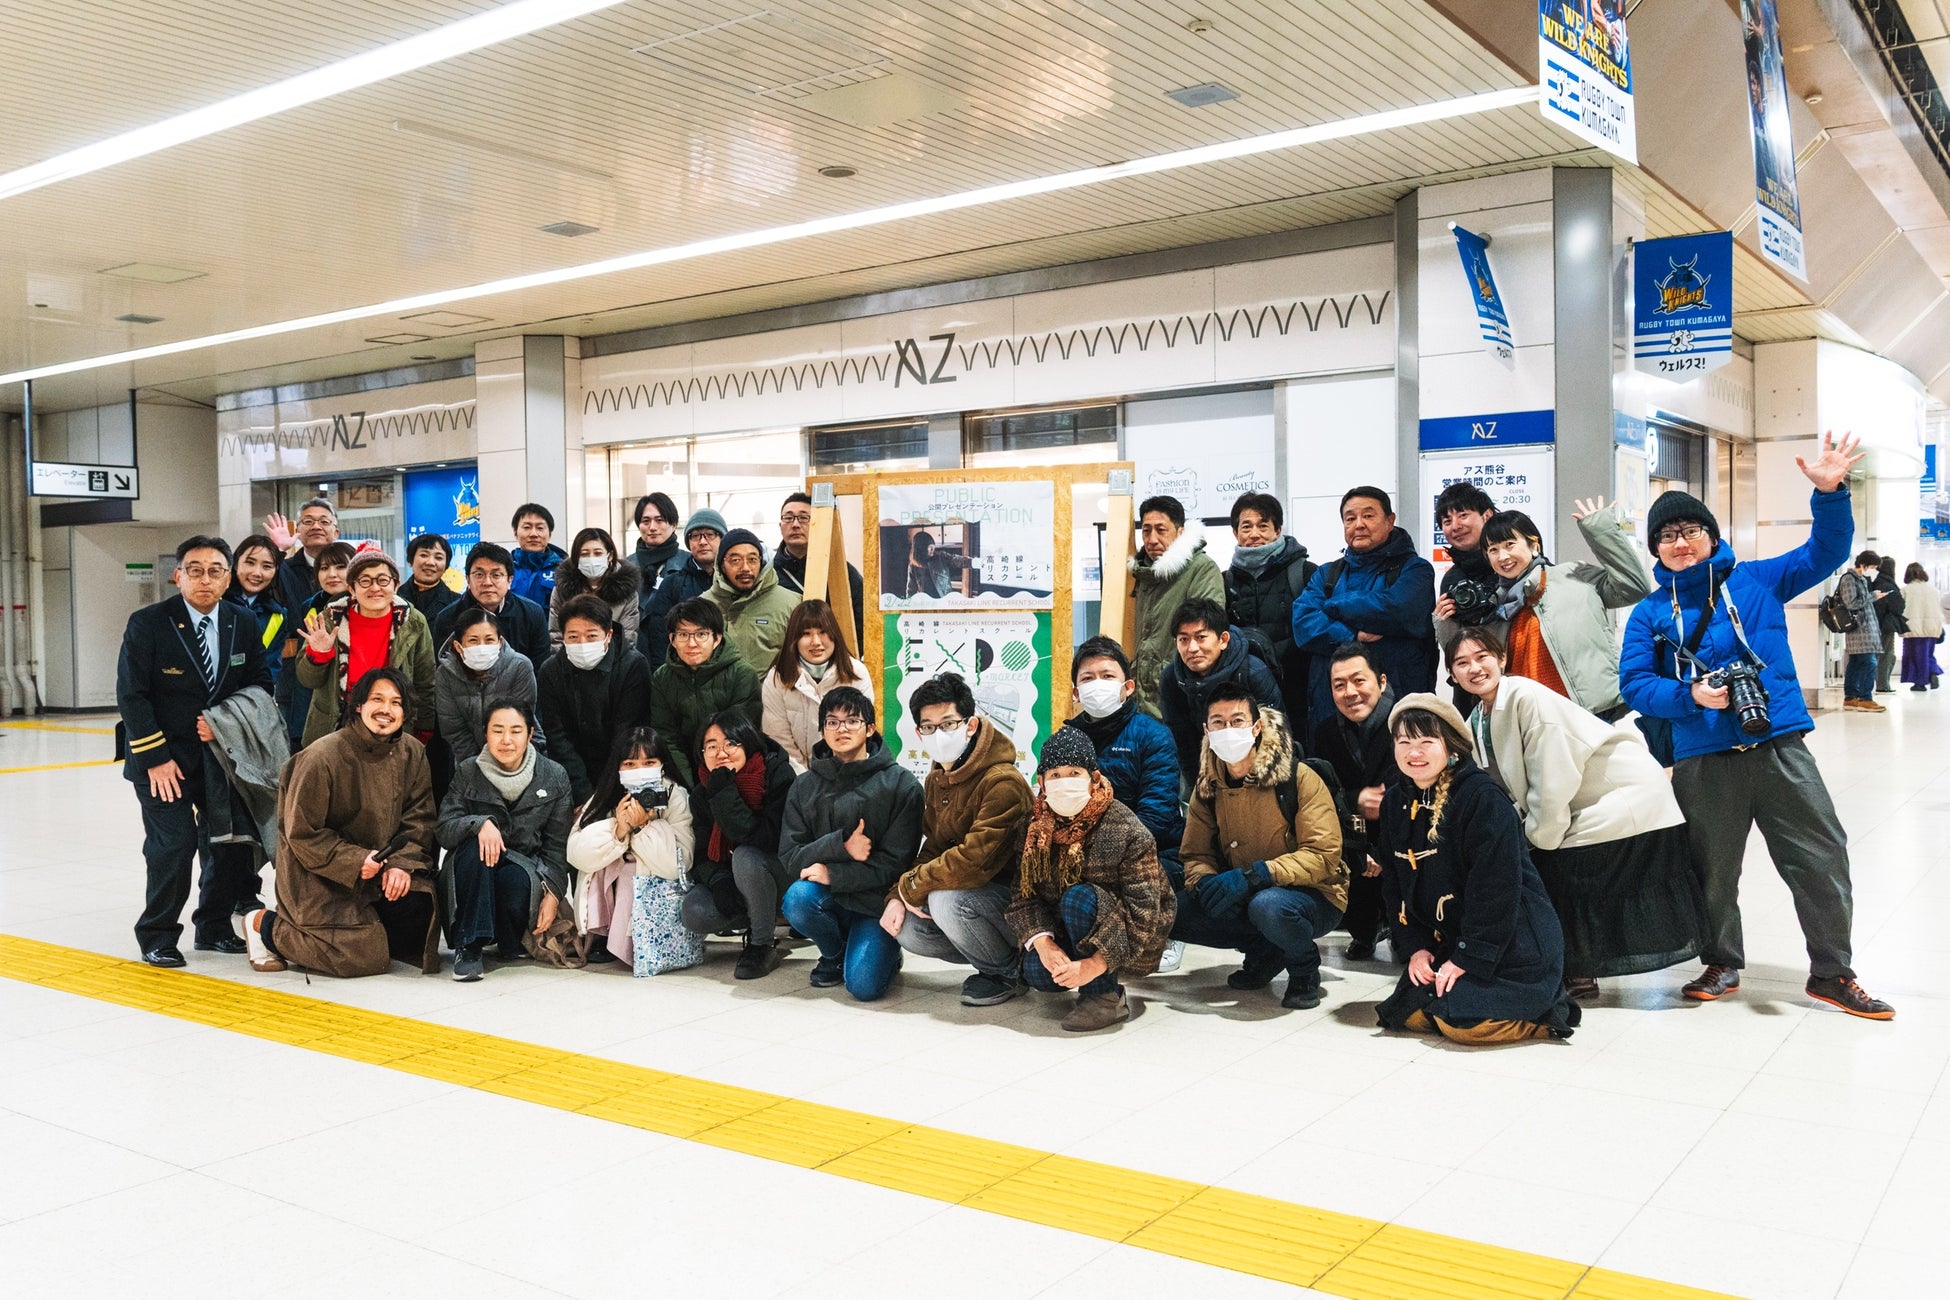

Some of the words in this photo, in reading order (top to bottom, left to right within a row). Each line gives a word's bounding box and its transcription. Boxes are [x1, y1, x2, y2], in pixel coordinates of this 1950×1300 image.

[1562, 3, 1584, 32] WE
[1586, 21, 1611, 55] ARE
[1541, 13, 1578, 51] WILD
[1579, 40, 1628, 88] KNIGHTS
[1581, 79, 1605, 108] RUGBY
[1606, 95, 1627, 124] TOWN
[1581, 106, 1621, 145] KUMAGAYA
[1664, 287, 1687, 302] WILD
[1667, 289, 1703, 313] KNIGHTS
[1639, 320, 1662, 329] RUGBY
[1666, 318, 1685, 327] TOWN
[1687, 315, 1726, 325] KUMAGAYA
[894, 333, 957, 389] AZ
[1471, 421, 1498, 440] AZ
[37, 468, 86, 478] エレベーター
[1463, 464, 1505, 476] アズ熊谷
[934, 487, 996, 503] PUBLIC
[1216, 480, 1270, 492] COSMETICS
[900, 508, 1033, 525] PRESENTATION
[905, 636, 1032, 685] EXPO
